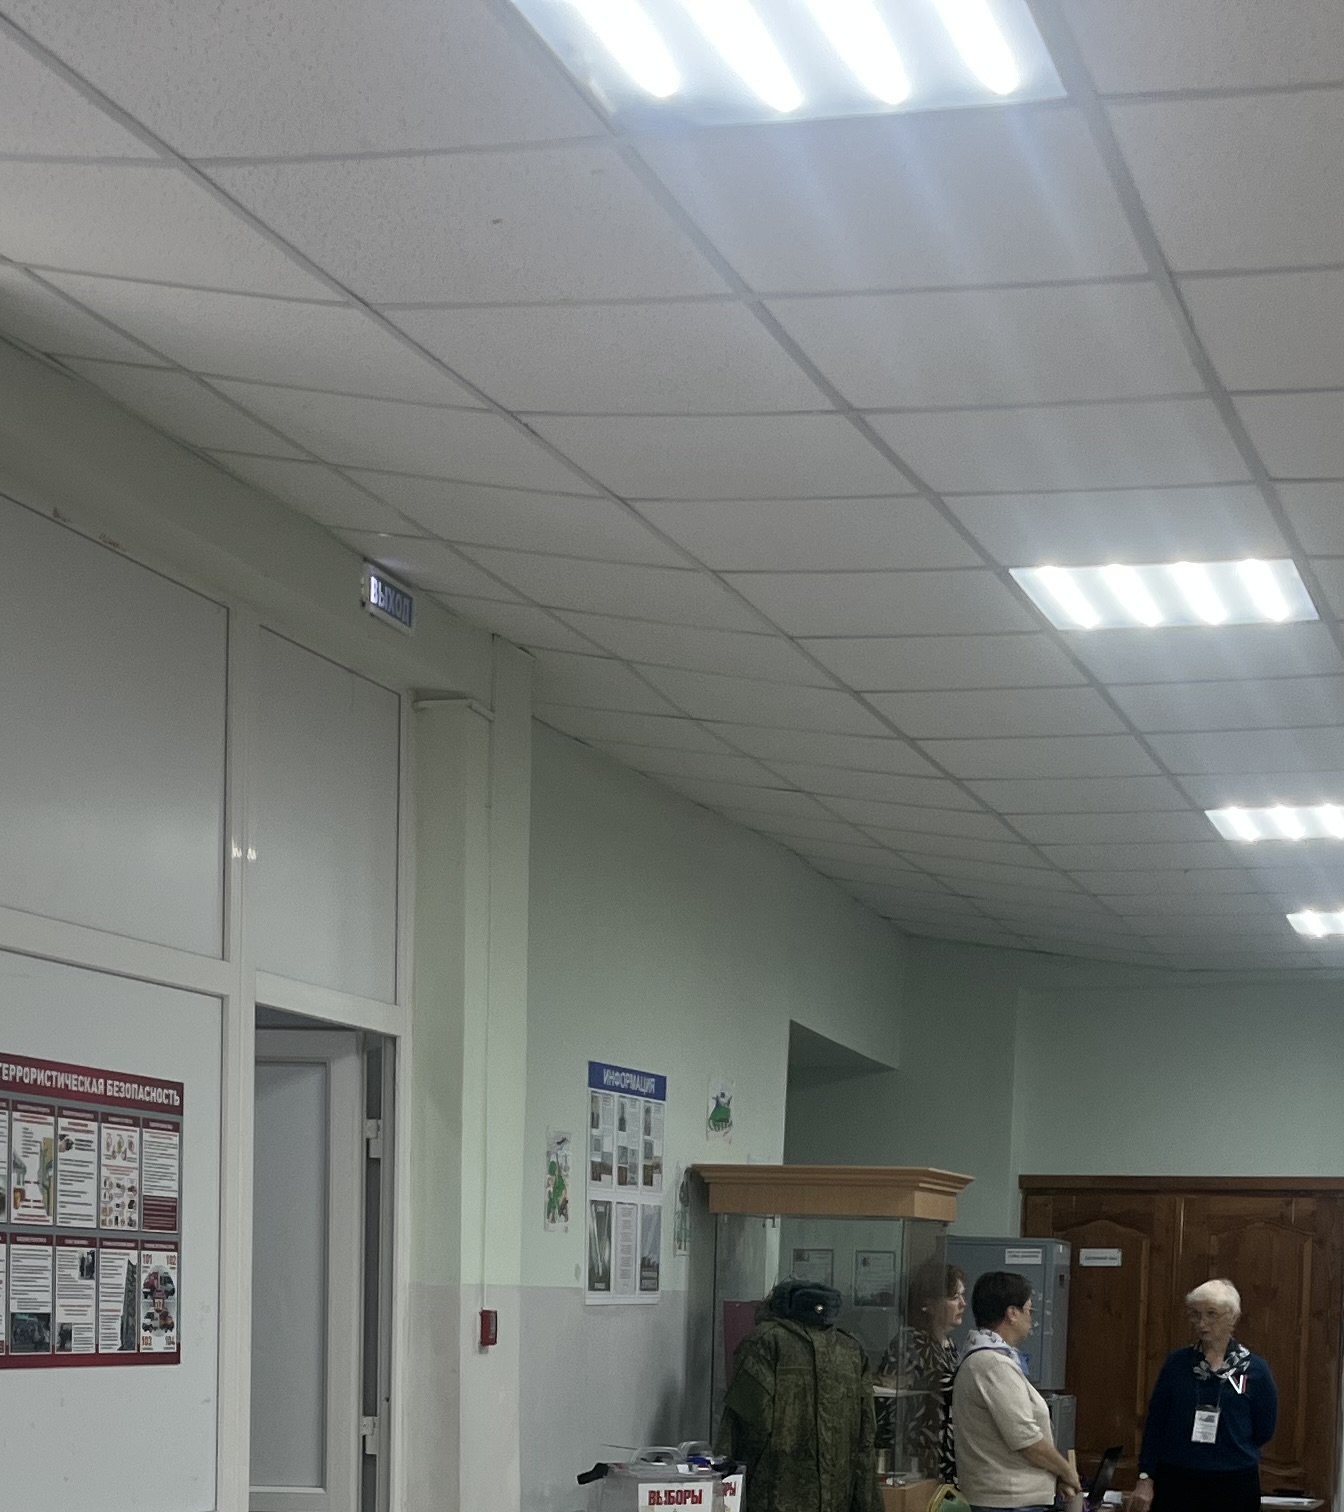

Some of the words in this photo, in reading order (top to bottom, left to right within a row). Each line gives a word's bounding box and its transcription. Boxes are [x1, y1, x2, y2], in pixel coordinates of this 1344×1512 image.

[369, 575, 411, 627] ВЫХОД
[106, 1079, 180, 1106] БЕЗОПАСНОСТЬ
[602, 1067, 656, 1095] ИНФОРМАЦИЯ
[648, 1489, 703, 1505] ВЫБОРЫ
